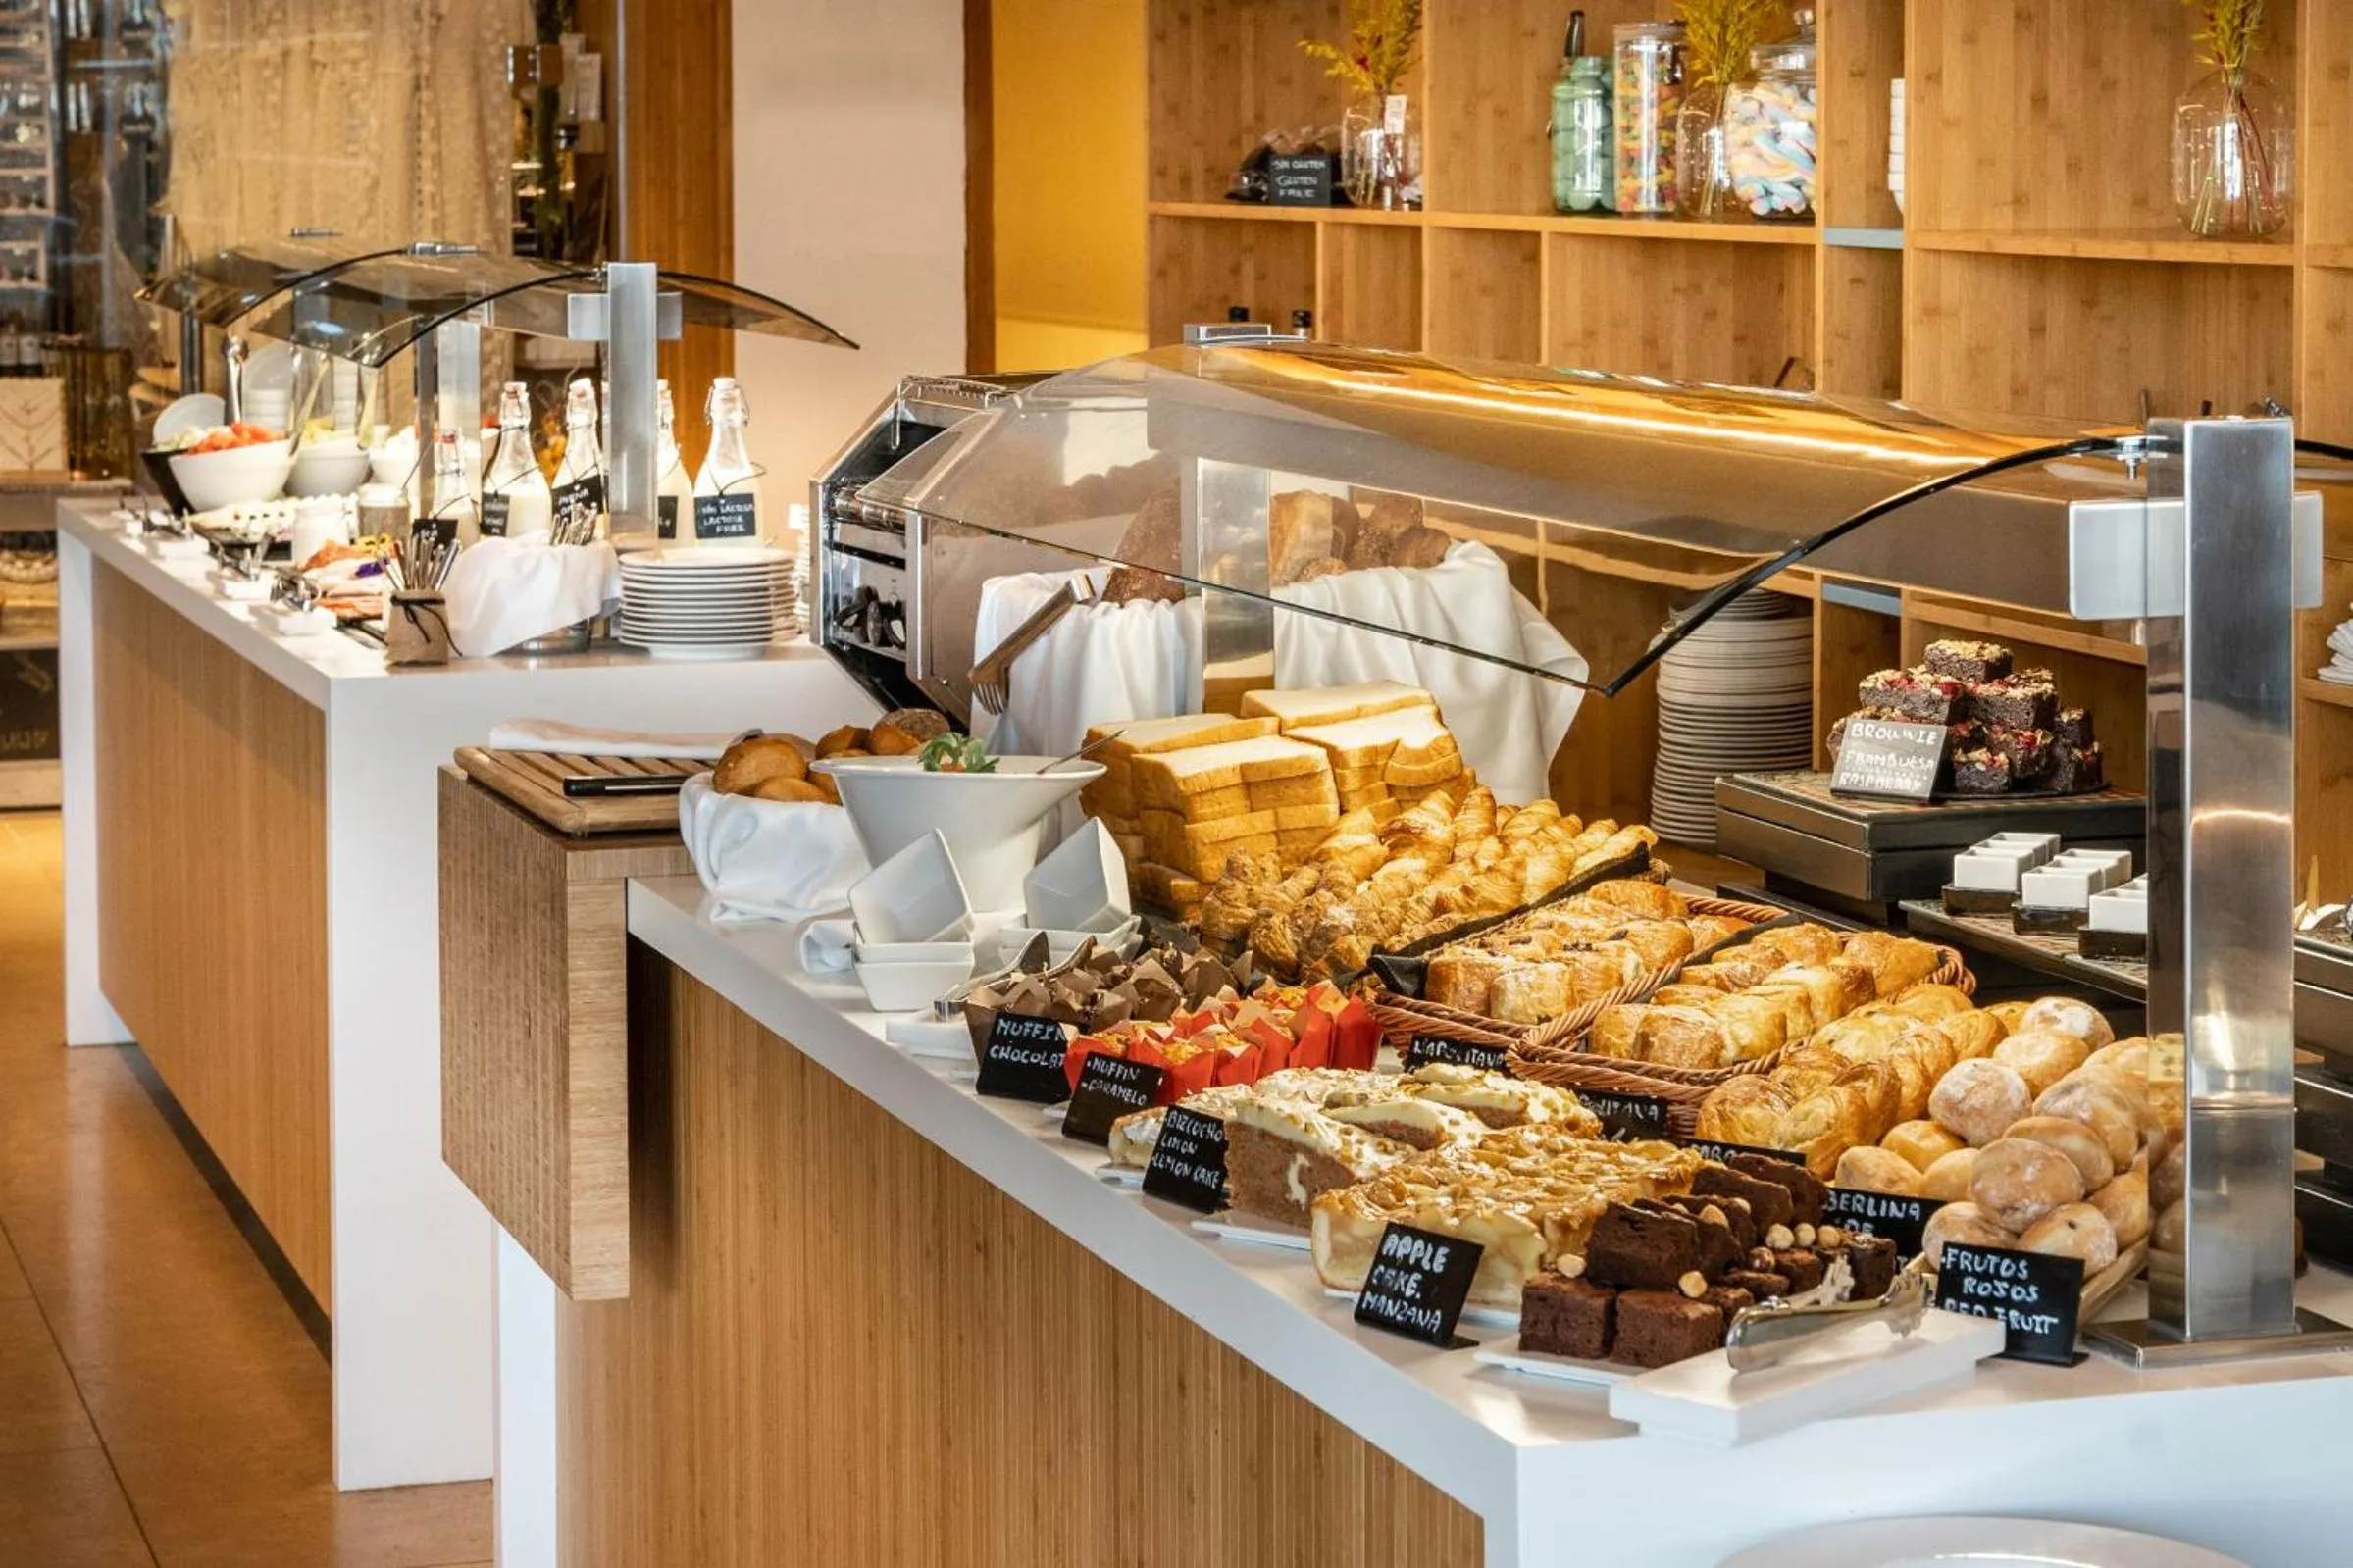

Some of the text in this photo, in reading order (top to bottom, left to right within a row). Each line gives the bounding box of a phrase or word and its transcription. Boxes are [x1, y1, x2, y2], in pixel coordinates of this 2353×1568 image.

[1851, 723, 1938, 745] BROWNIE
[996, 1018, 1065, 1041] MUFFIN
[1382, 1234, 1450, 1273] APPLE
[1946, 1247, 2029, 1280] FRUTOS
[1362, 1291, 1442, 1333] MANZANA
